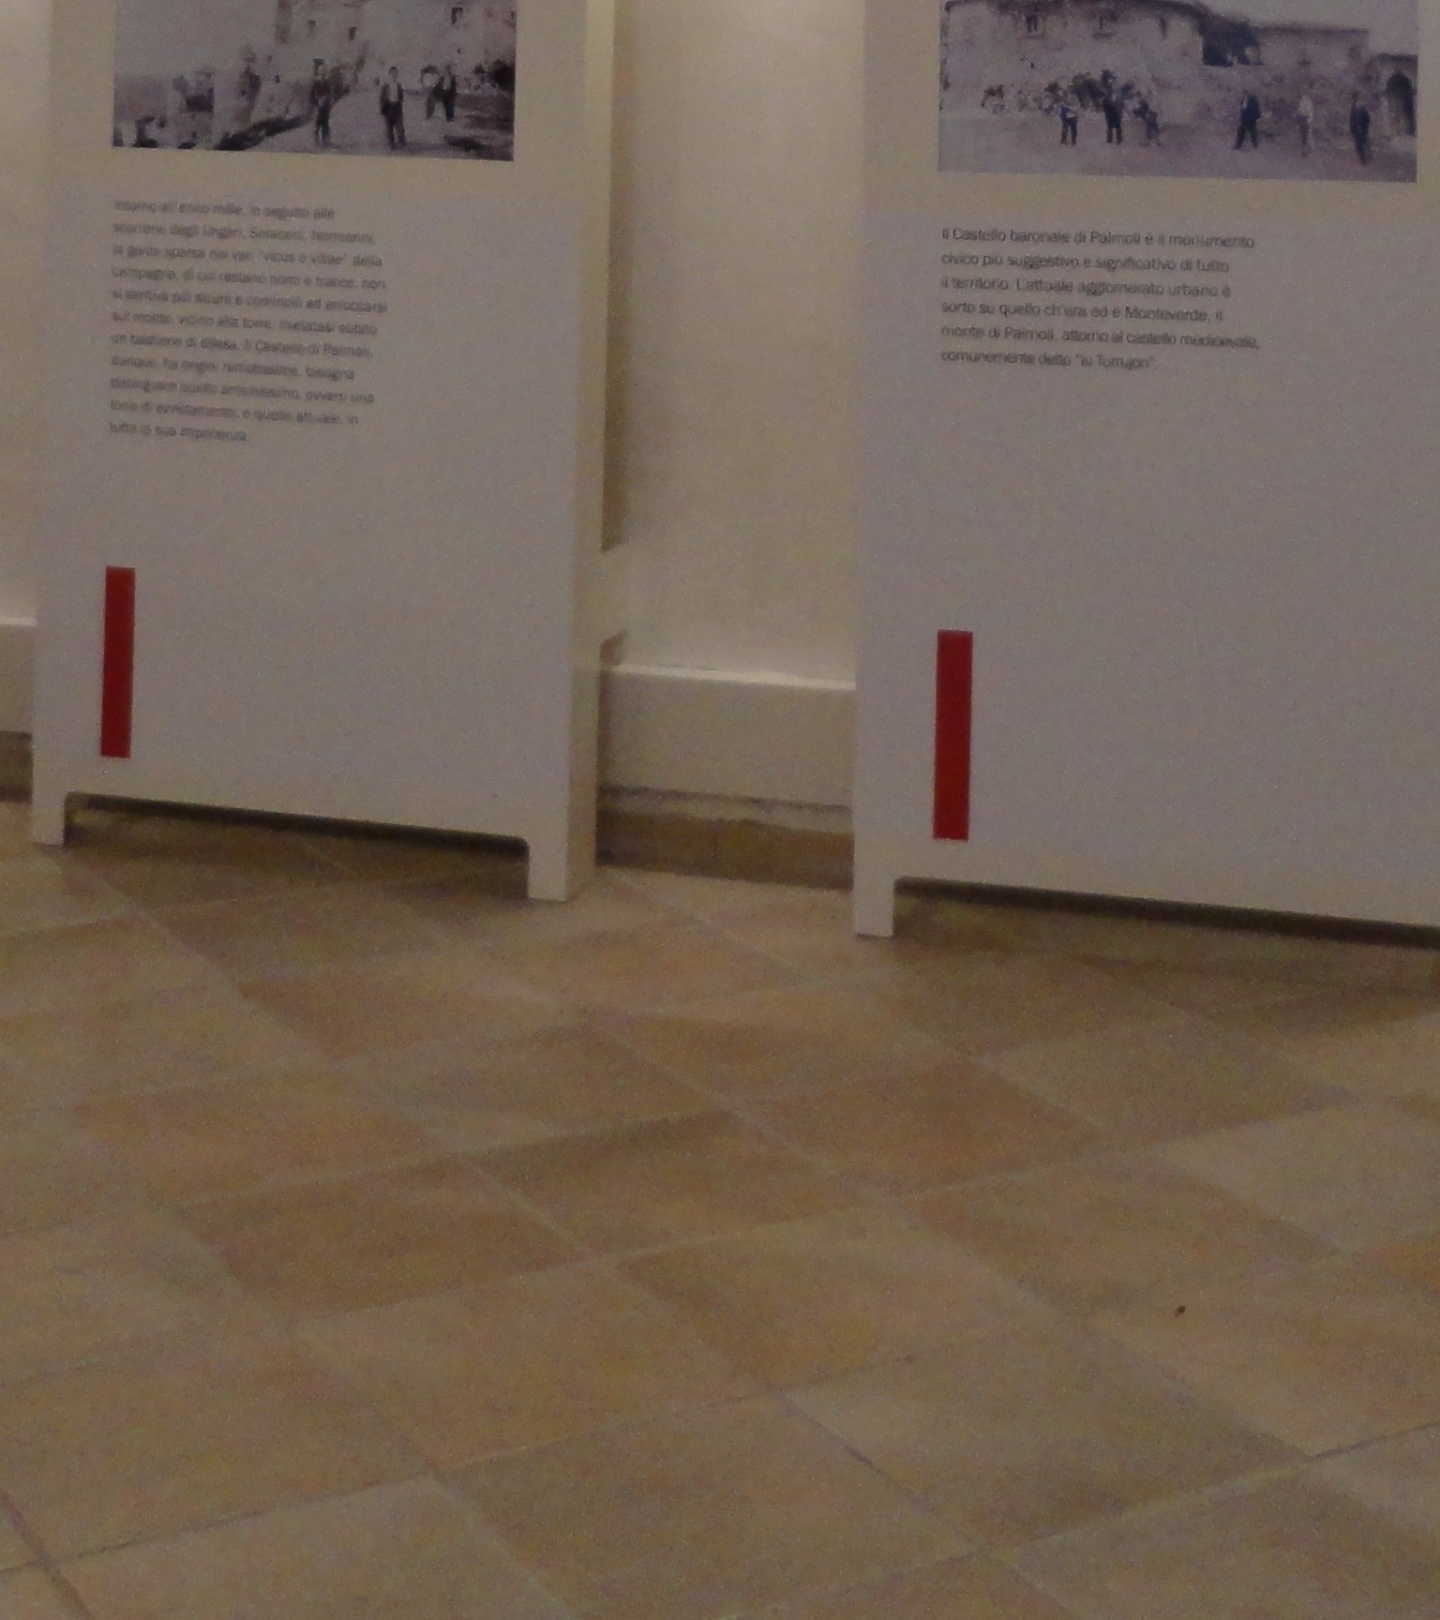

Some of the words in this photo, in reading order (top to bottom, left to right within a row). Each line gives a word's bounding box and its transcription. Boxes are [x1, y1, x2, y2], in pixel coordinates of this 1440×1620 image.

[953, 227, 1006, 241] Castello
[1010, 229, 1069, 243] baronale
[1074, 230, 1085, 243] di
[1091, 231, 1140, 244] Palmoli
[1169, 235, 1254, 248] monumento
[942, 252, 978, 265] civico
[983, 253, 1002, 269] più
[1008, 255, 1078, 270] suggestivo
[1084, 259, 1091, 268] e
[1096, 256, 1174, 272] significativo
[1180, 258, 1192, 271] di
[1197, 259, 1229, 272] tutto
[1168, 284, 1218, 297] urbano
[980, 305, 995, 314] su
[1000, 303, 1040, 318] quello
[1091, 305, 1107, 318] ed
[942, 325, 984, 338] monte
[941, 351, 1035, 364] comunemente
[1039, 352, 1071, 366] detto
